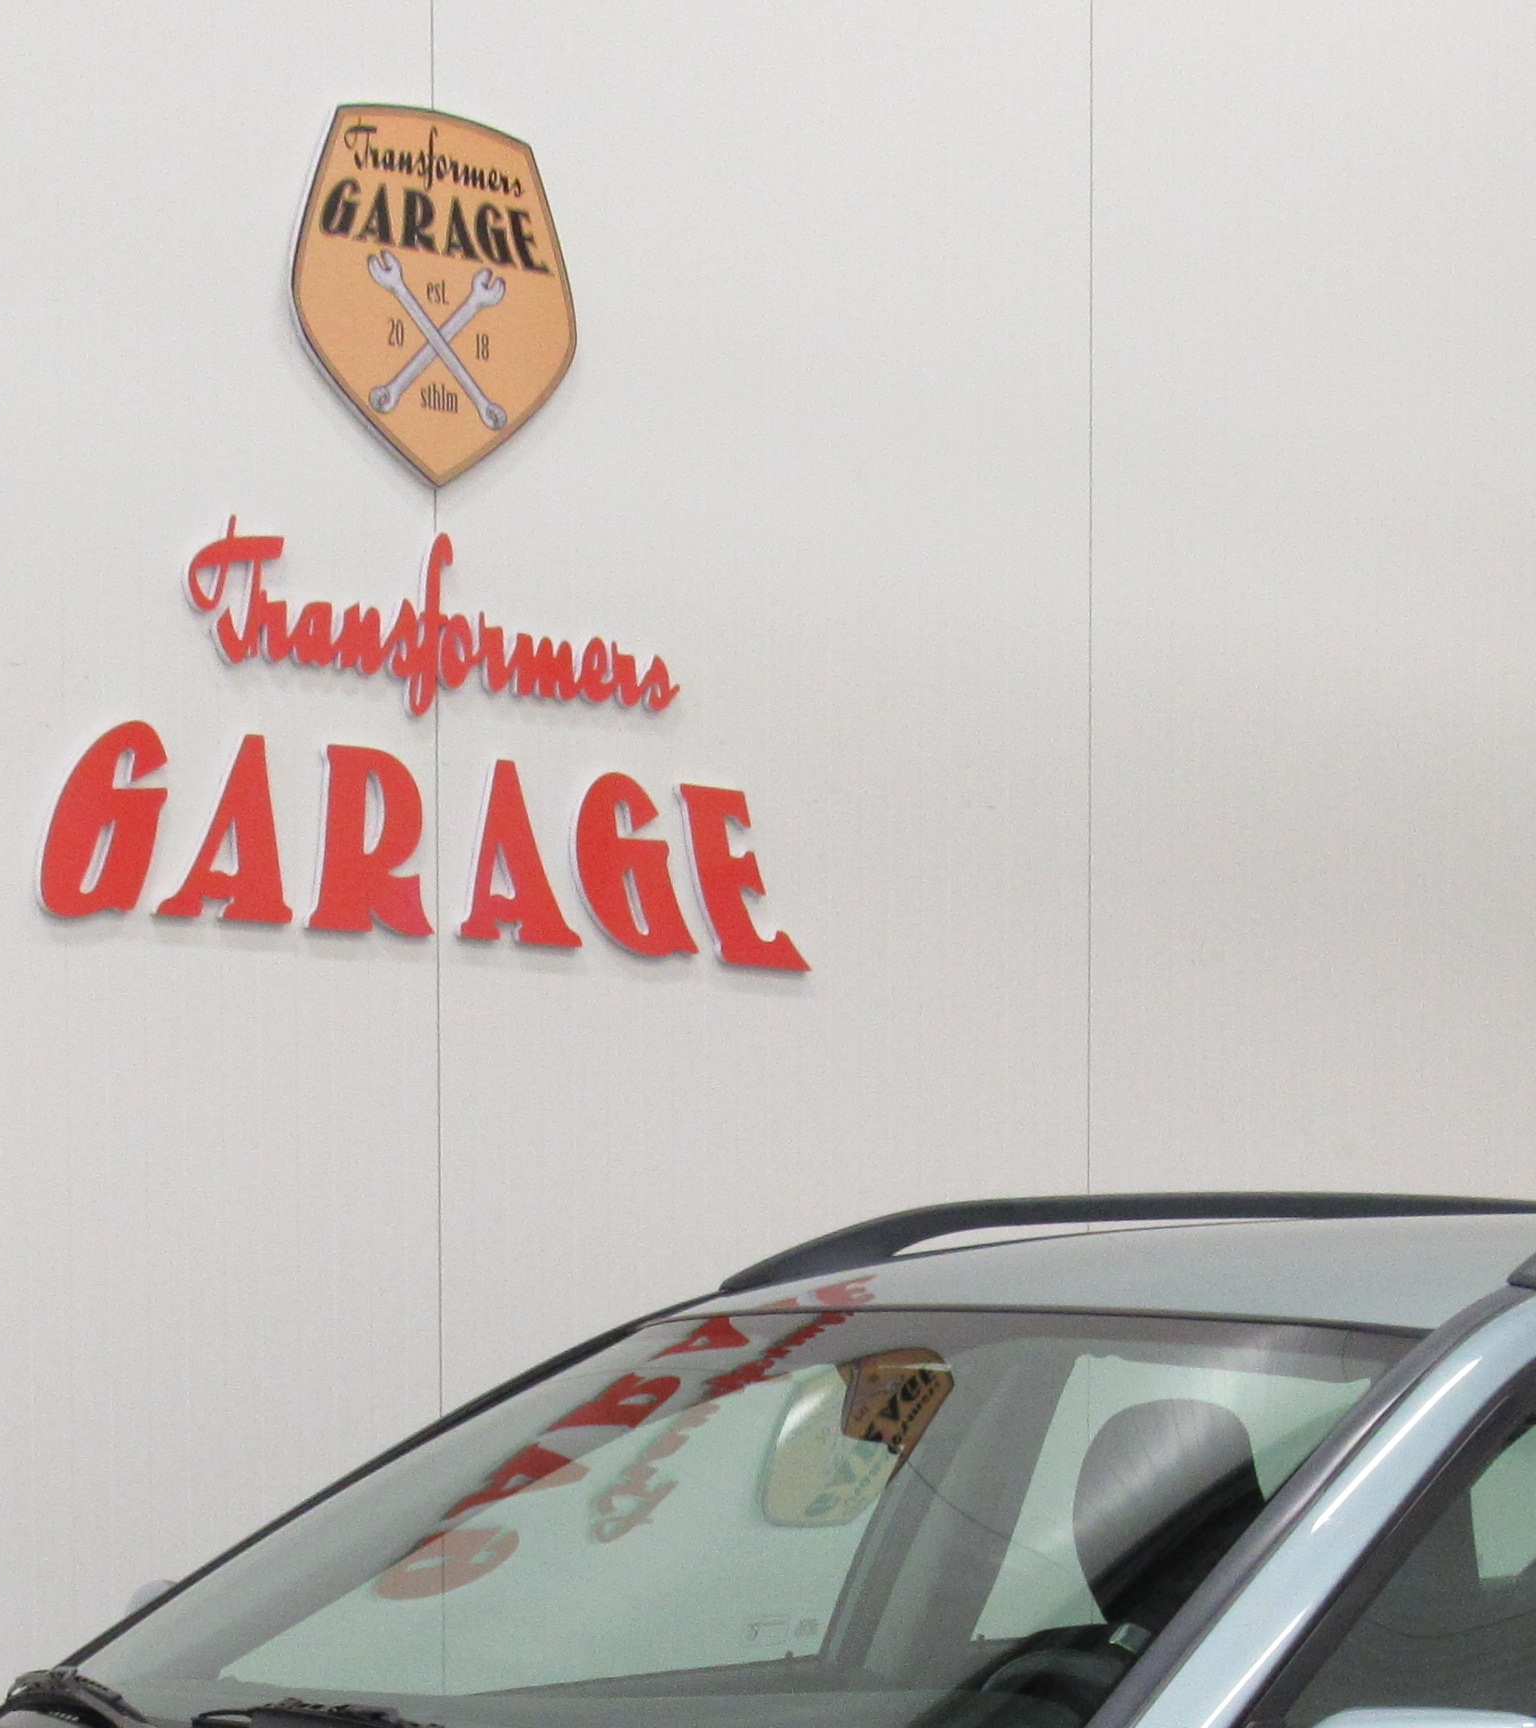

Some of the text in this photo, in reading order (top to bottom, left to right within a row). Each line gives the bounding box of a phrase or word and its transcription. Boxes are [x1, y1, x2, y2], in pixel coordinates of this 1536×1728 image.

[344, 118, 524, 198] Transformers
[321, 177, 551, 275] GARAGE
[387, 318, 490, 360] 20 18
[420, 383, 458, 412] sthlm
[181, 513, 681, 718] Transformers
[36, 719, 812, 972] GARAGE
